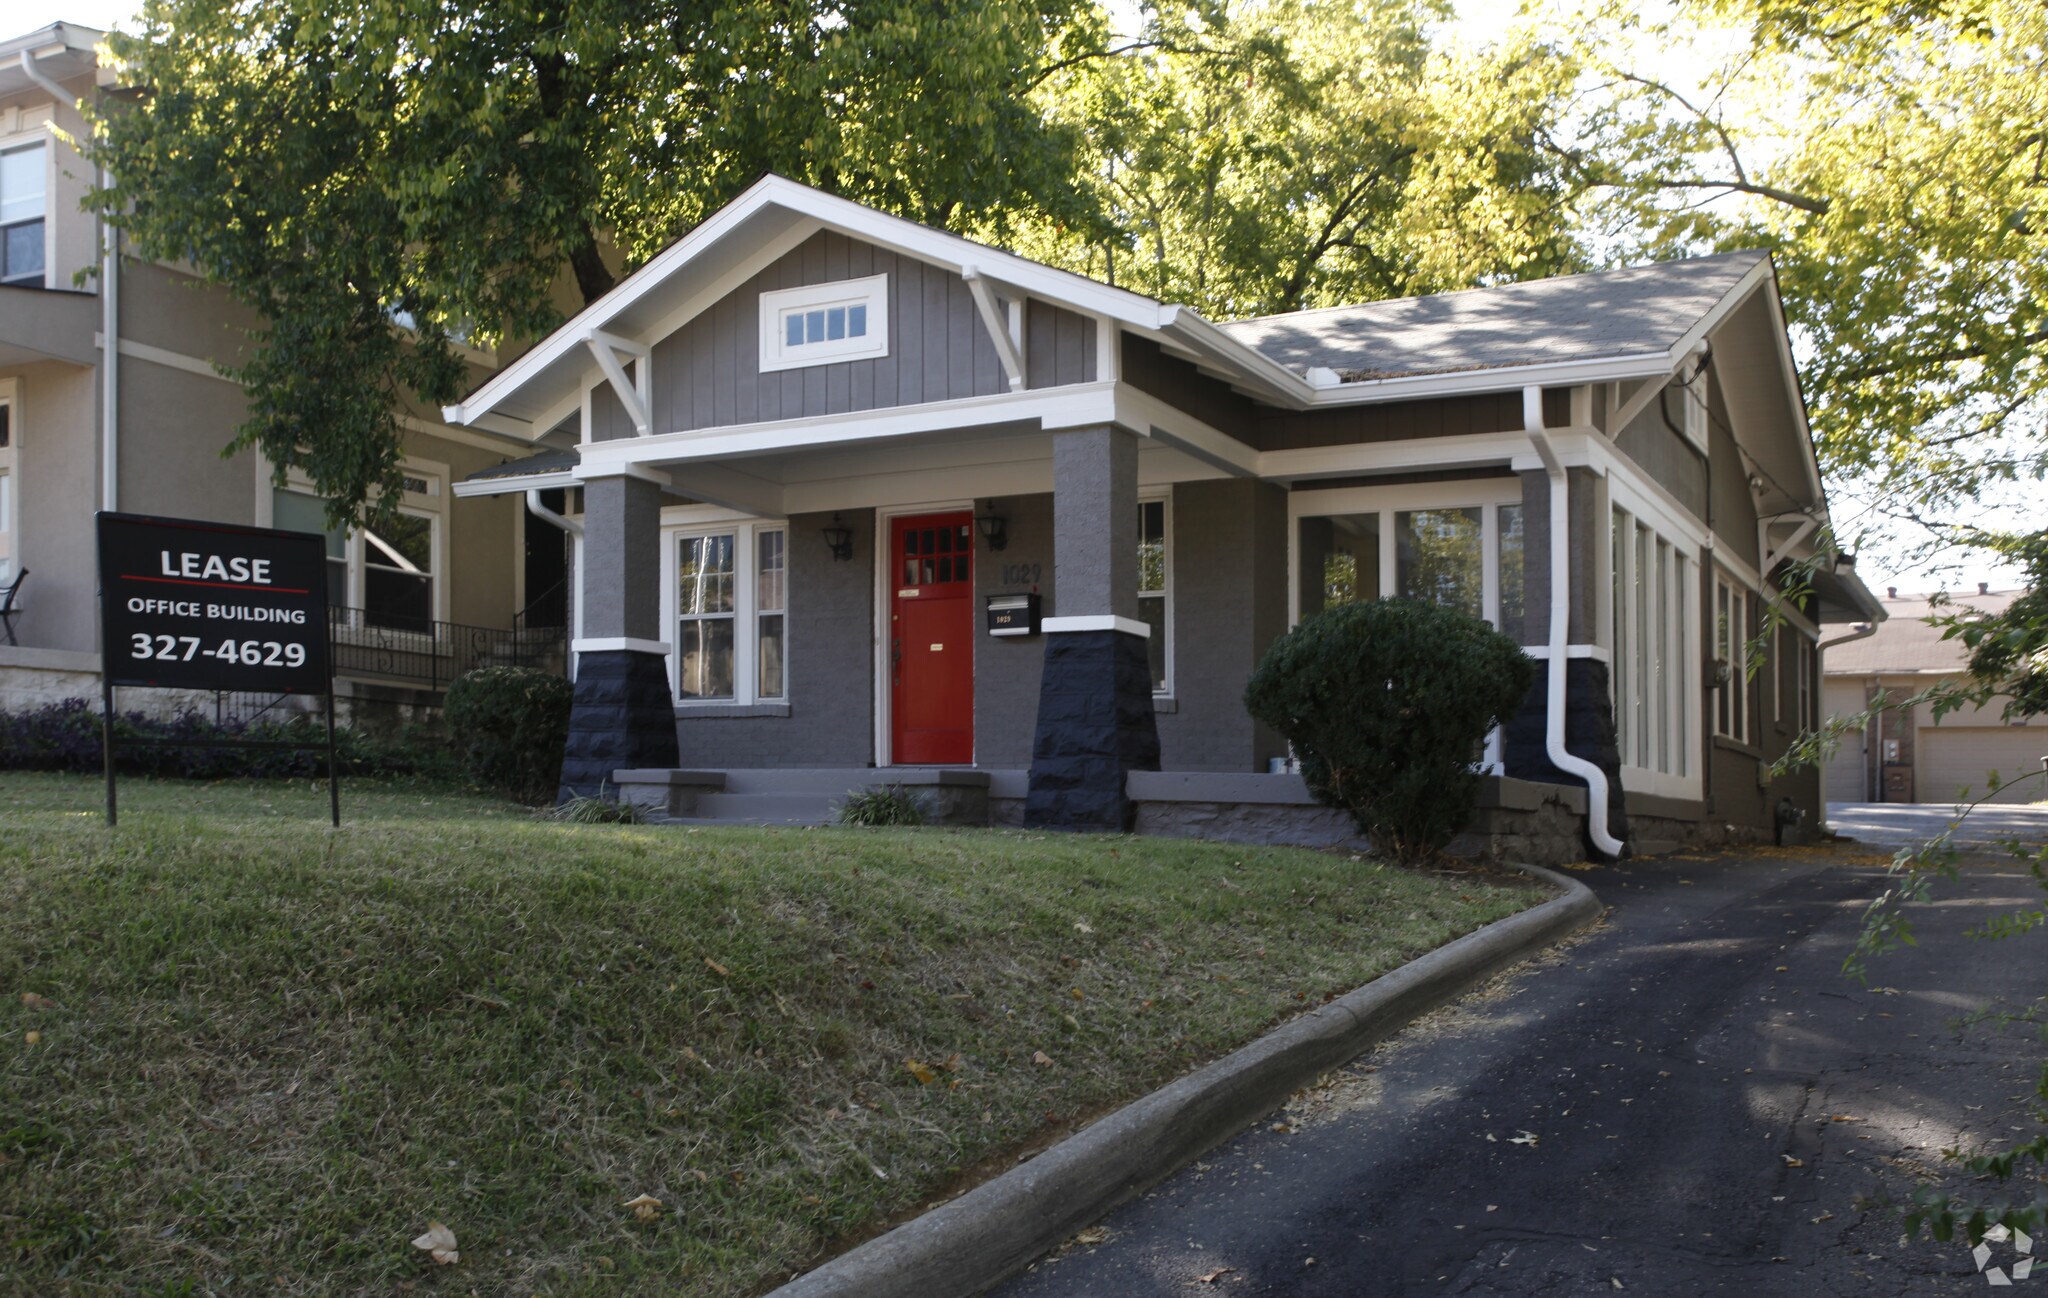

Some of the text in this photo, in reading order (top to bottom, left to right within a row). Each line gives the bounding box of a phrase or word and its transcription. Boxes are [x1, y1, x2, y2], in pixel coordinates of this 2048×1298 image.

[161, 550, 272, 584] LEASE
[1003, 563, 1042, 585] 1029
[127, 597, 306, 625] OFFICE BUILDING
[131, 632, 306, 668] 327-4629
